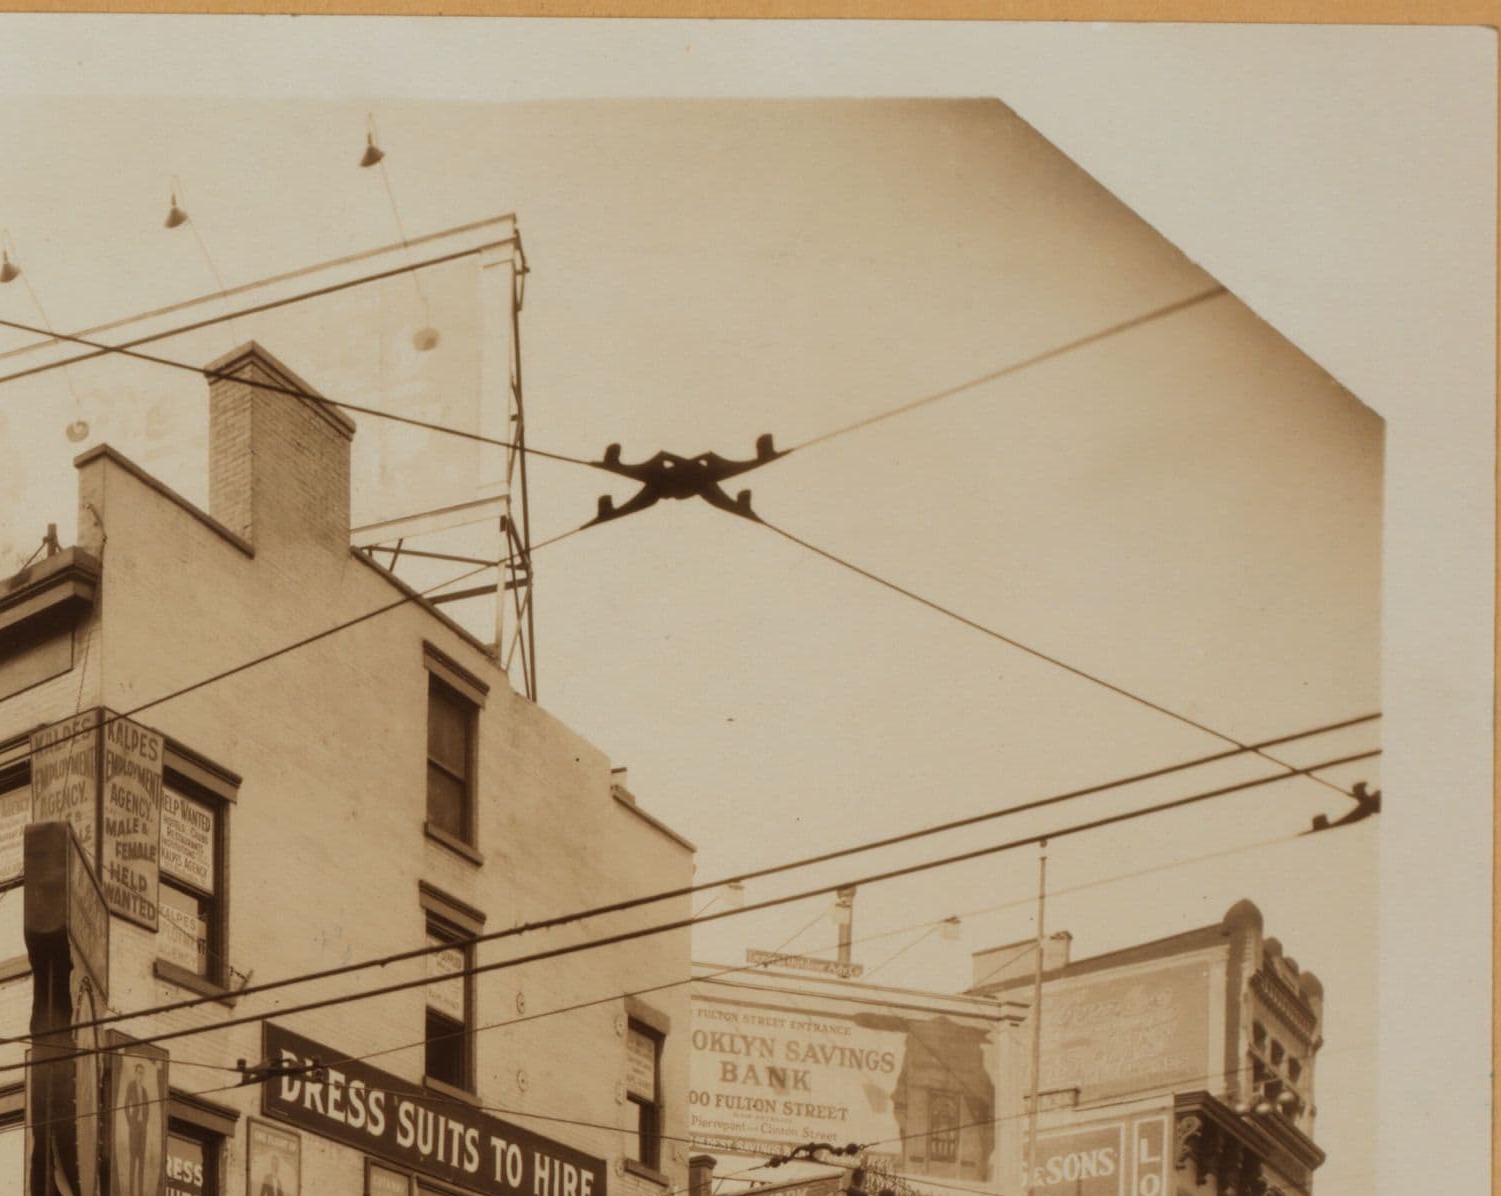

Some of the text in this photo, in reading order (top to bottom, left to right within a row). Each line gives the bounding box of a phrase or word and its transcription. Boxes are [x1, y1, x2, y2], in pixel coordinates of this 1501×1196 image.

[33, 717, 95, 758] KALPES
[106, 716, 159, 762] KALPES
[35, 747, 97, 788] EMPLOYMENT
[106, 749, 162, 810] EMPLOYMENT
[110, 783, 153, 823] AGENCY.
[164, 794, 211, 833] ELP WANTED
[105, 816, 139, 838] MALE
[115, 841, 157, 864] FEMALE
[102, 883, 156, 922] WANTED
[696, 1007, 852, 1037] FULTON STREET ENTRANCE
[690, 1029, 897, 1074] OKLYN SAVINGS
[718, 1060, 813, 1092] BANK
[279, 1048, 387, 1137] DRESS
[396, 1099, 480, 1174] SUITS
[489, 1135, 524, 1189] TO
[715, 1093, 777, 1114] FULTON
[782, 1098, 851, 1121] STREET
[1046, 1147, 1117, 1186] SONS
